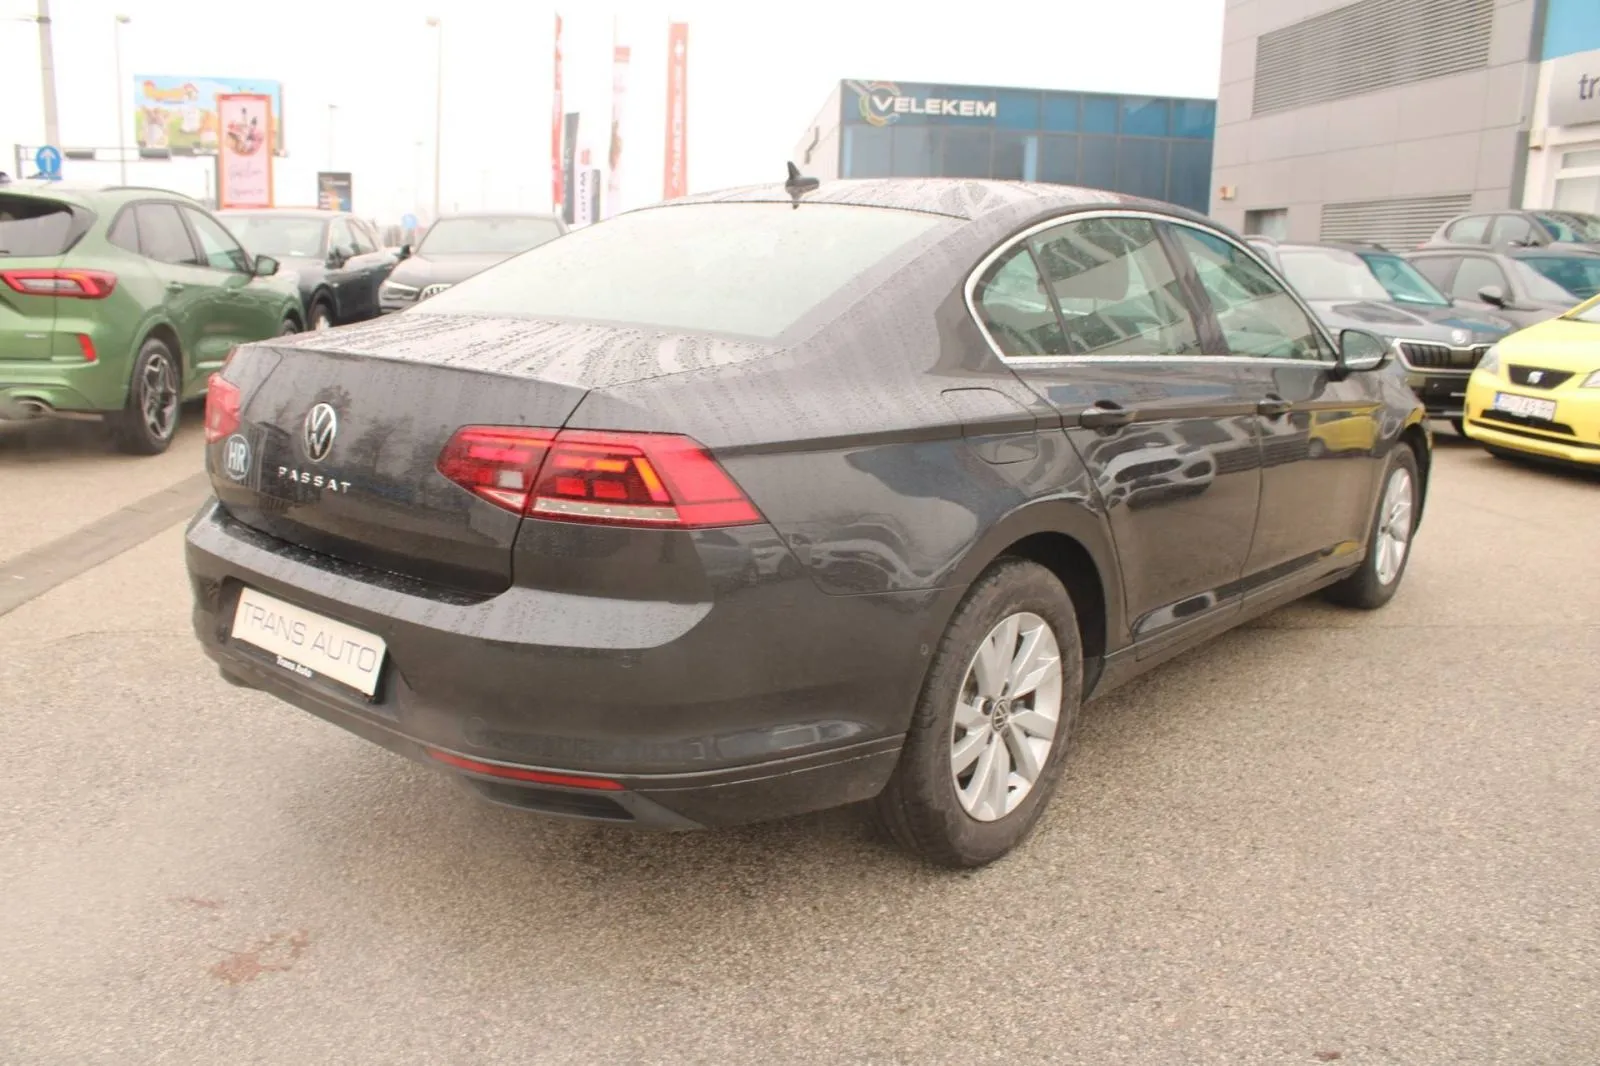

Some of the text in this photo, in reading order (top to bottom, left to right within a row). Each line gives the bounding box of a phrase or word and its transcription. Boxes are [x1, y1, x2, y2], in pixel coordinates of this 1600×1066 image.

[1577, 73, 1600, 100] tr
[872, 95, 997, 118] VELEKEM
[228, 440, 247, 473] HR
[277, 466, 352, 494] PASSAT
[242, 601, 377, 673] TRANS AUTO
